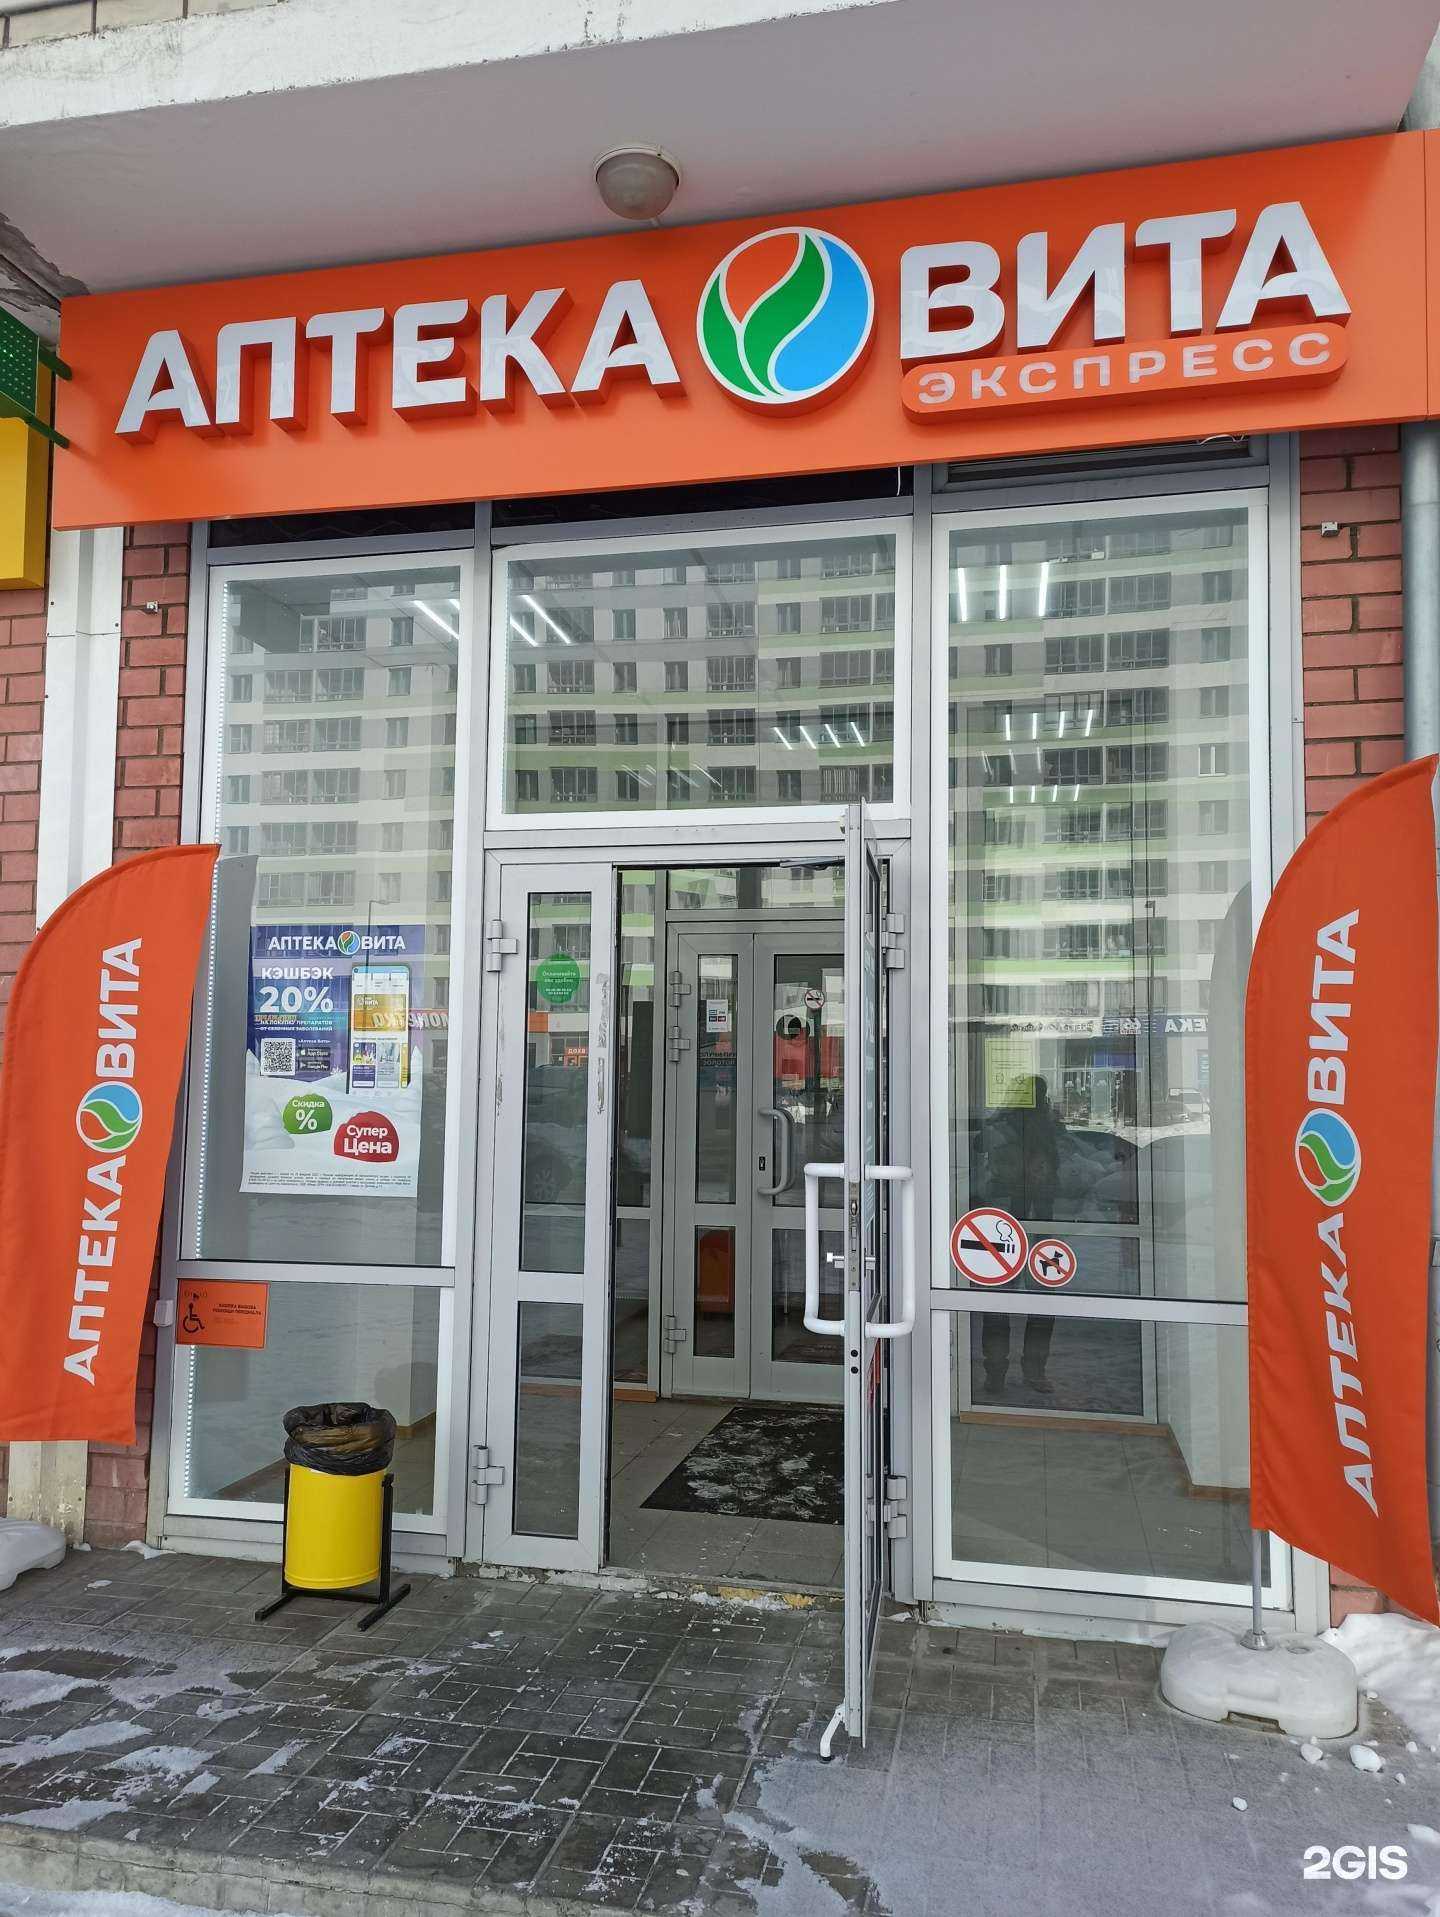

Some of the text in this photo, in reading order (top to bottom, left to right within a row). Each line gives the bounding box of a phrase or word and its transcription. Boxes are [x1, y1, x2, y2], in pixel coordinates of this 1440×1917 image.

[115, 201, 1352, 436] АПТЕКА ВИТА
[918, 332, 1331, 404] ЭКСПРЕСС
[268, 936, 406, 950] АПТЕКА ВИТА
[261, 967, 334, 980] КЭШБЭК
[259, 986, 334, 1013] 20%
[292, 1099, 325, 1109] Скидка
[346, 1124, 388, 1139] Супер
[343, 1137, 392, 1156] Цена
[64, 938, 143, 1387] АПТЕКА ВИТА
[1308, 908, 1381, 1519] АПТЕКА ВИТА
